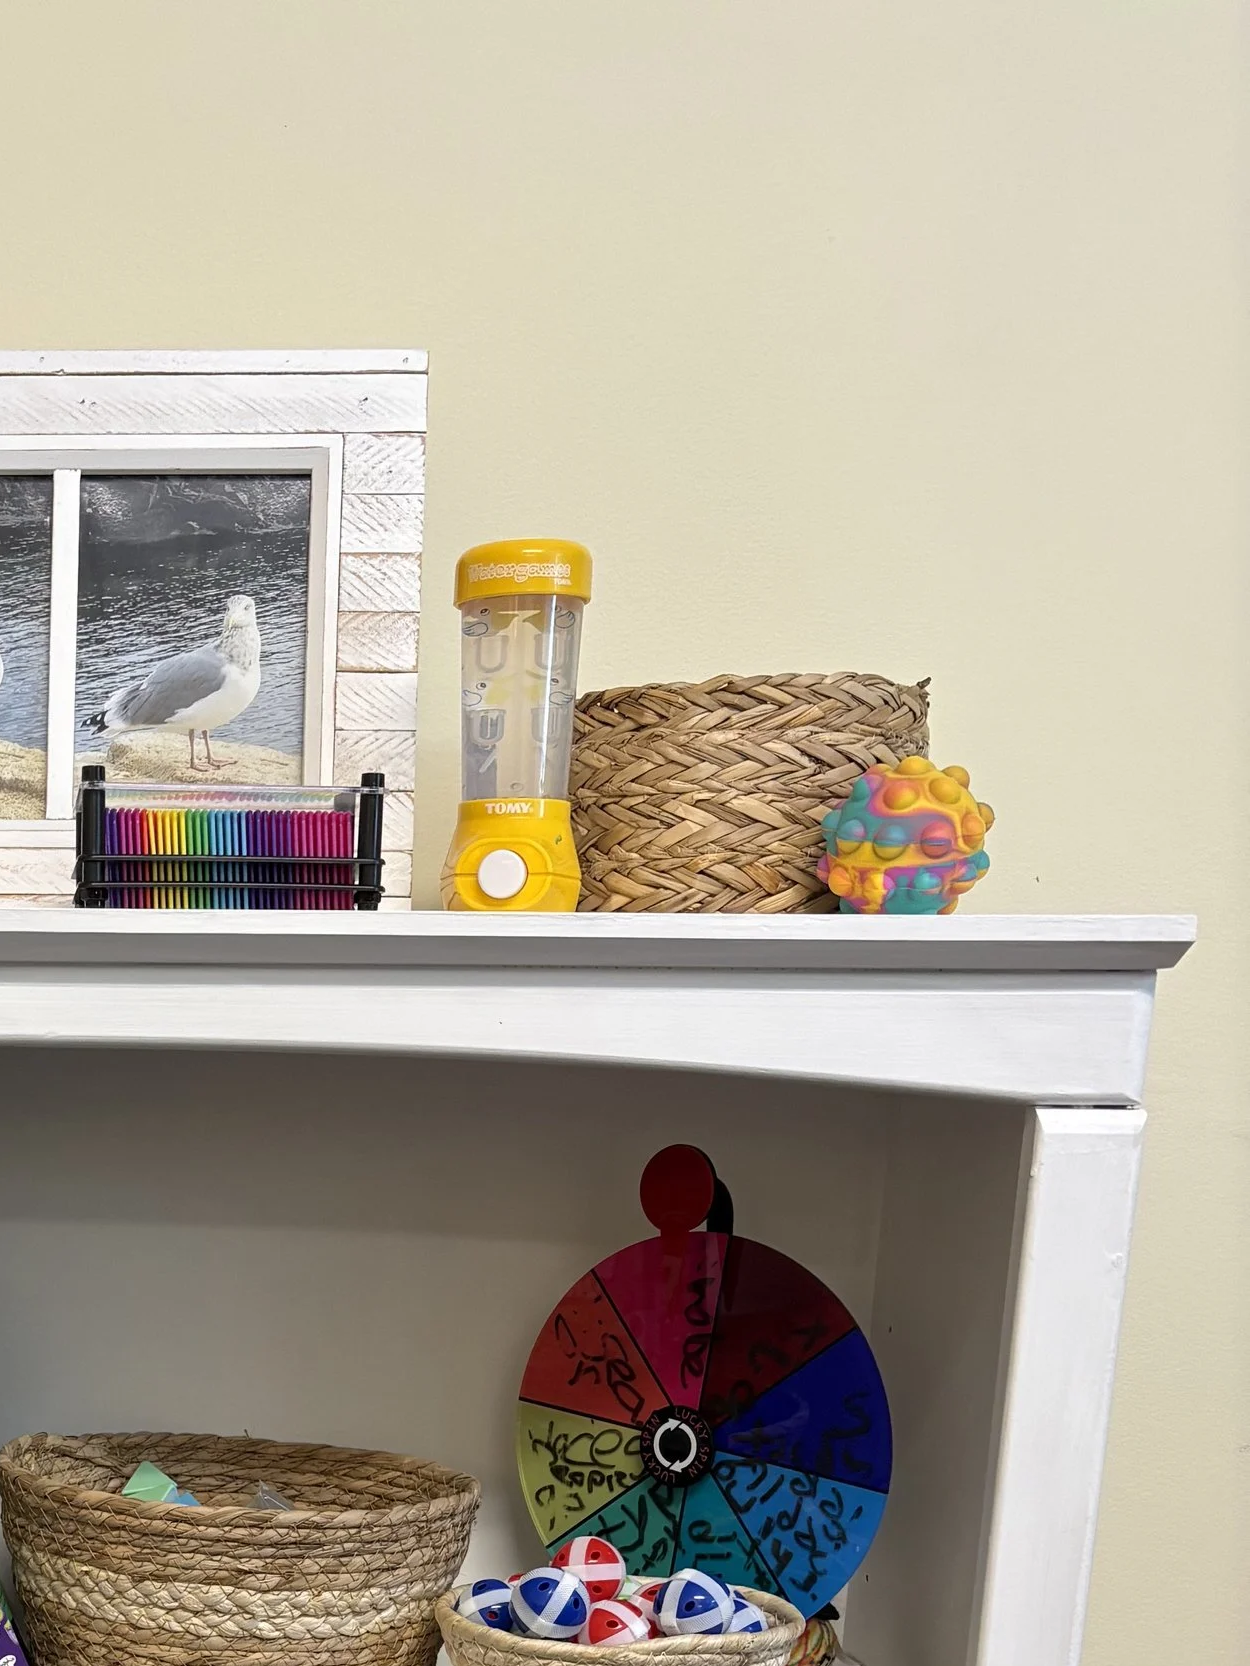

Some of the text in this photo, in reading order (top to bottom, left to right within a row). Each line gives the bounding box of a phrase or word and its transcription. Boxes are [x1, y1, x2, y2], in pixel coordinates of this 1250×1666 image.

[485, 803, 533, 815] TOMY
[673, 1407, 709, 1442] LUCKY
[641, 1414, 678, 1485] LUCKY SPIN
[689, 1444, 710, 1479] SPIN
